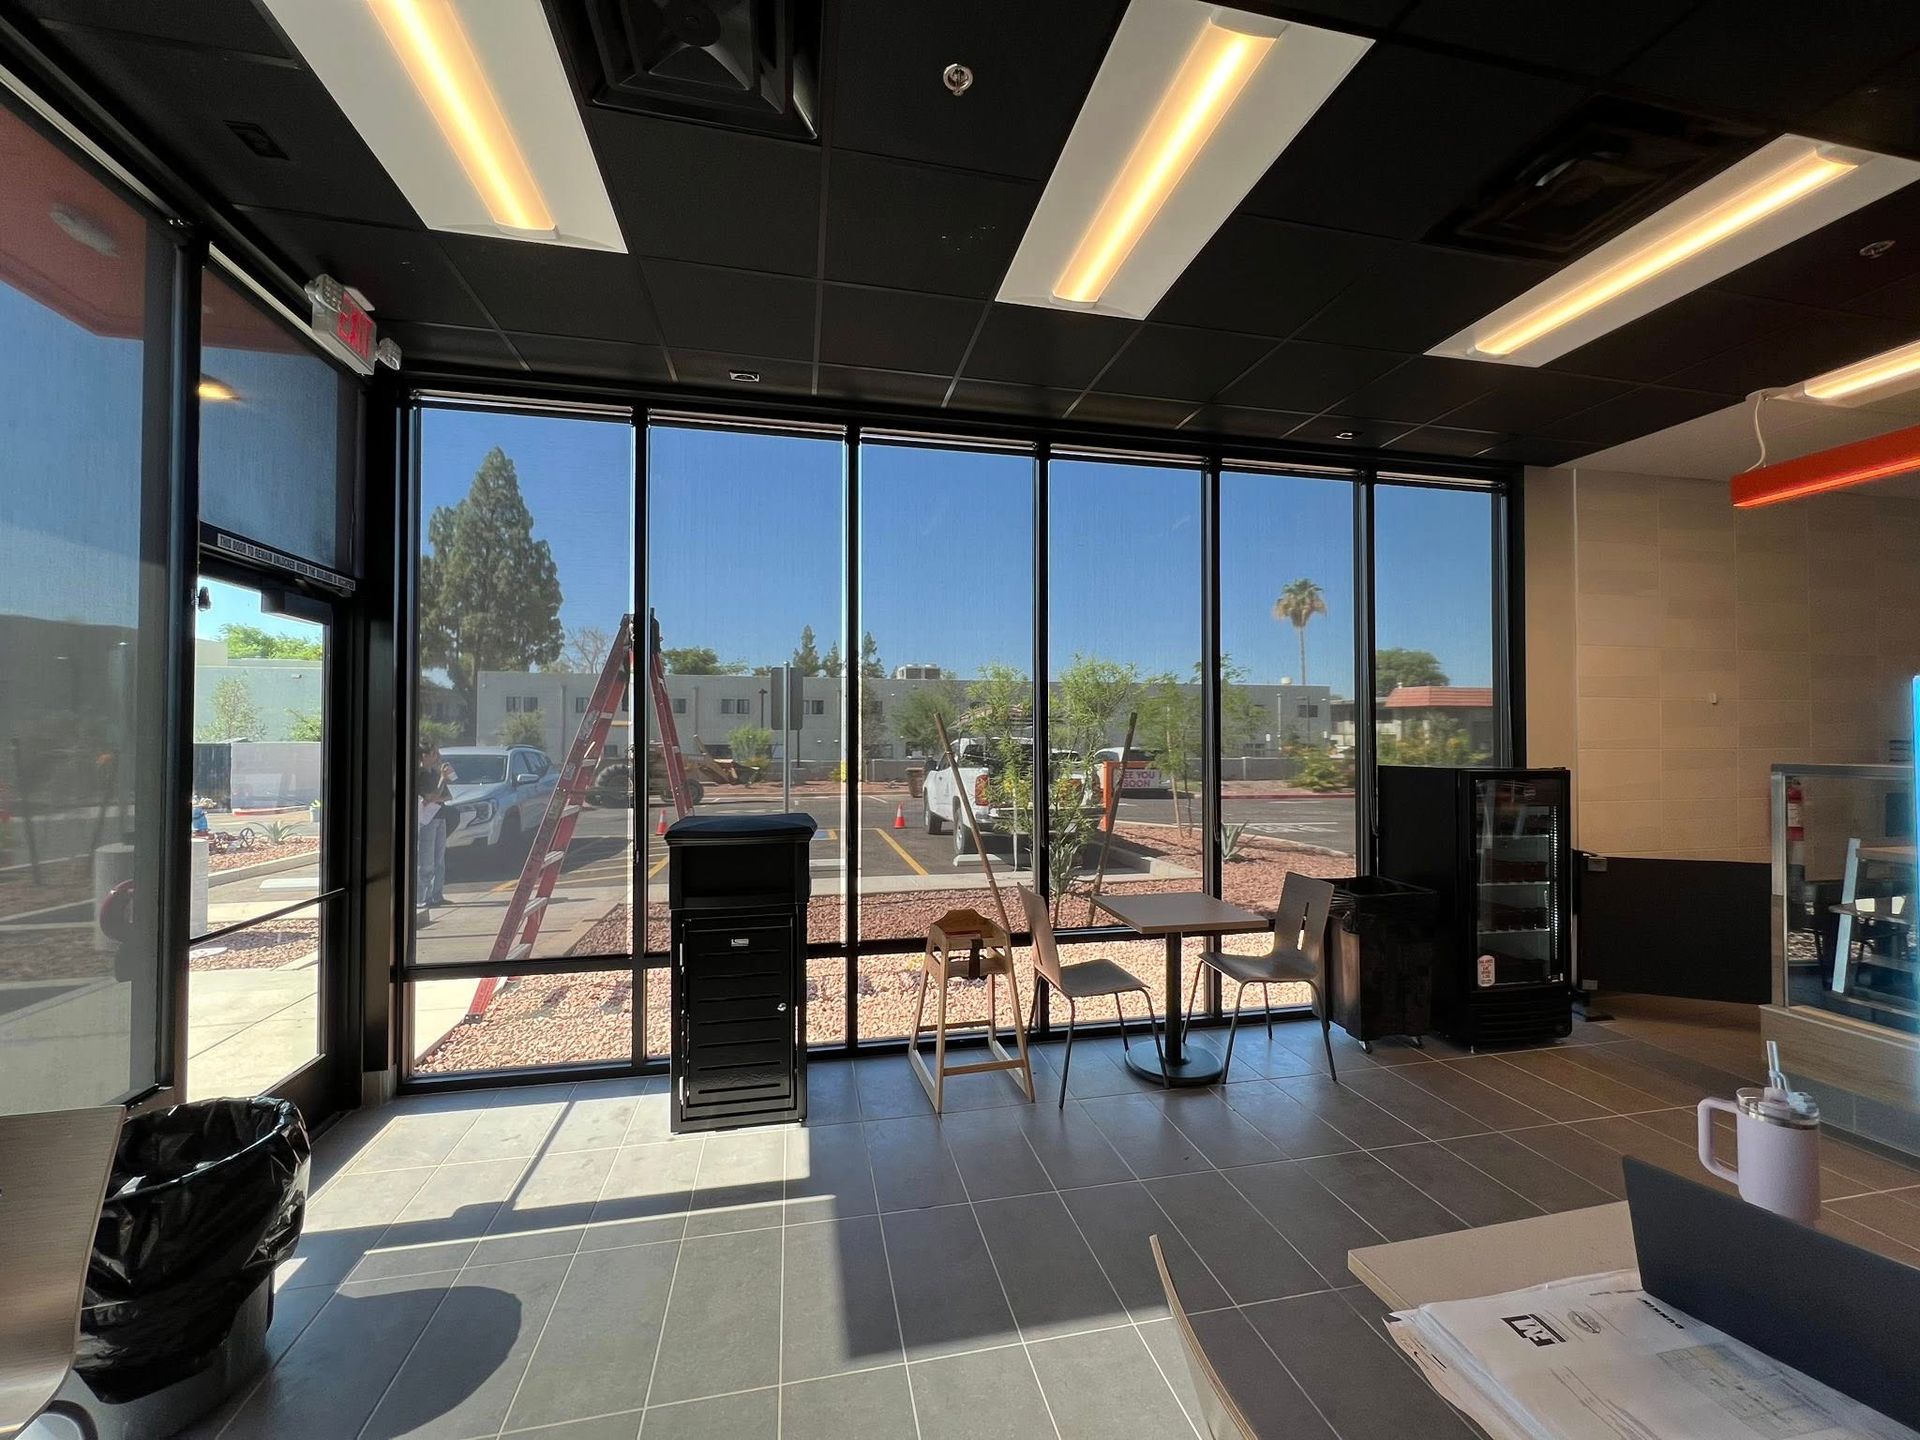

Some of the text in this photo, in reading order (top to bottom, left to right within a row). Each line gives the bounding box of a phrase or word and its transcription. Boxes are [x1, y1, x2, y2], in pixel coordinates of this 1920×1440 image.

[337, 291, 373, 361] EXIT
[233, 540, 246, 555] DOOR
[248, 545, 254, 557] TO
[1136, 771, 1155, 779] YOU
[1123, 780, 1151, 788] SOON
